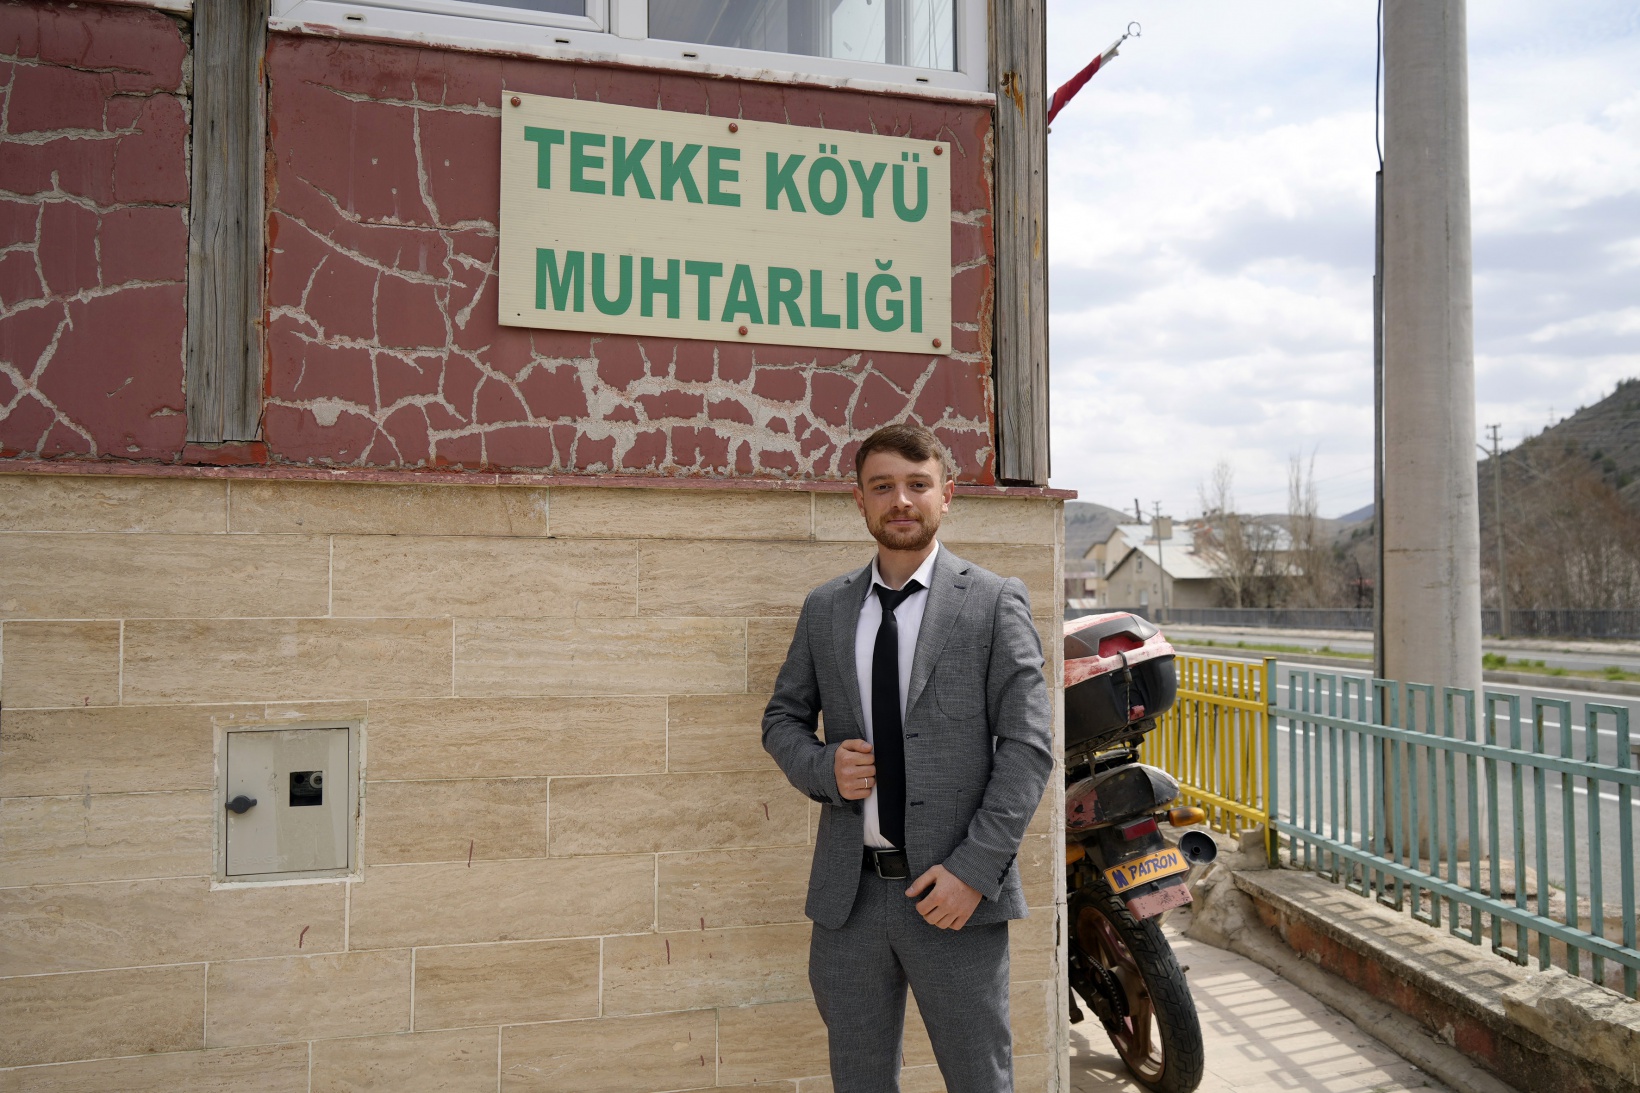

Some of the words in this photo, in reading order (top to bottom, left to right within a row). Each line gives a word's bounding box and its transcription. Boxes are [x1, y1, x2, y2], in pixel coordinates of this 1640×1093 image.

[524, 125, 741, 207] TEKKE
[766, 143, 928, 223] KÖYÜ
[535, 247, 923, 333] MUHTARLIĞI
[1128, 853, 1178, 881] PATRON
